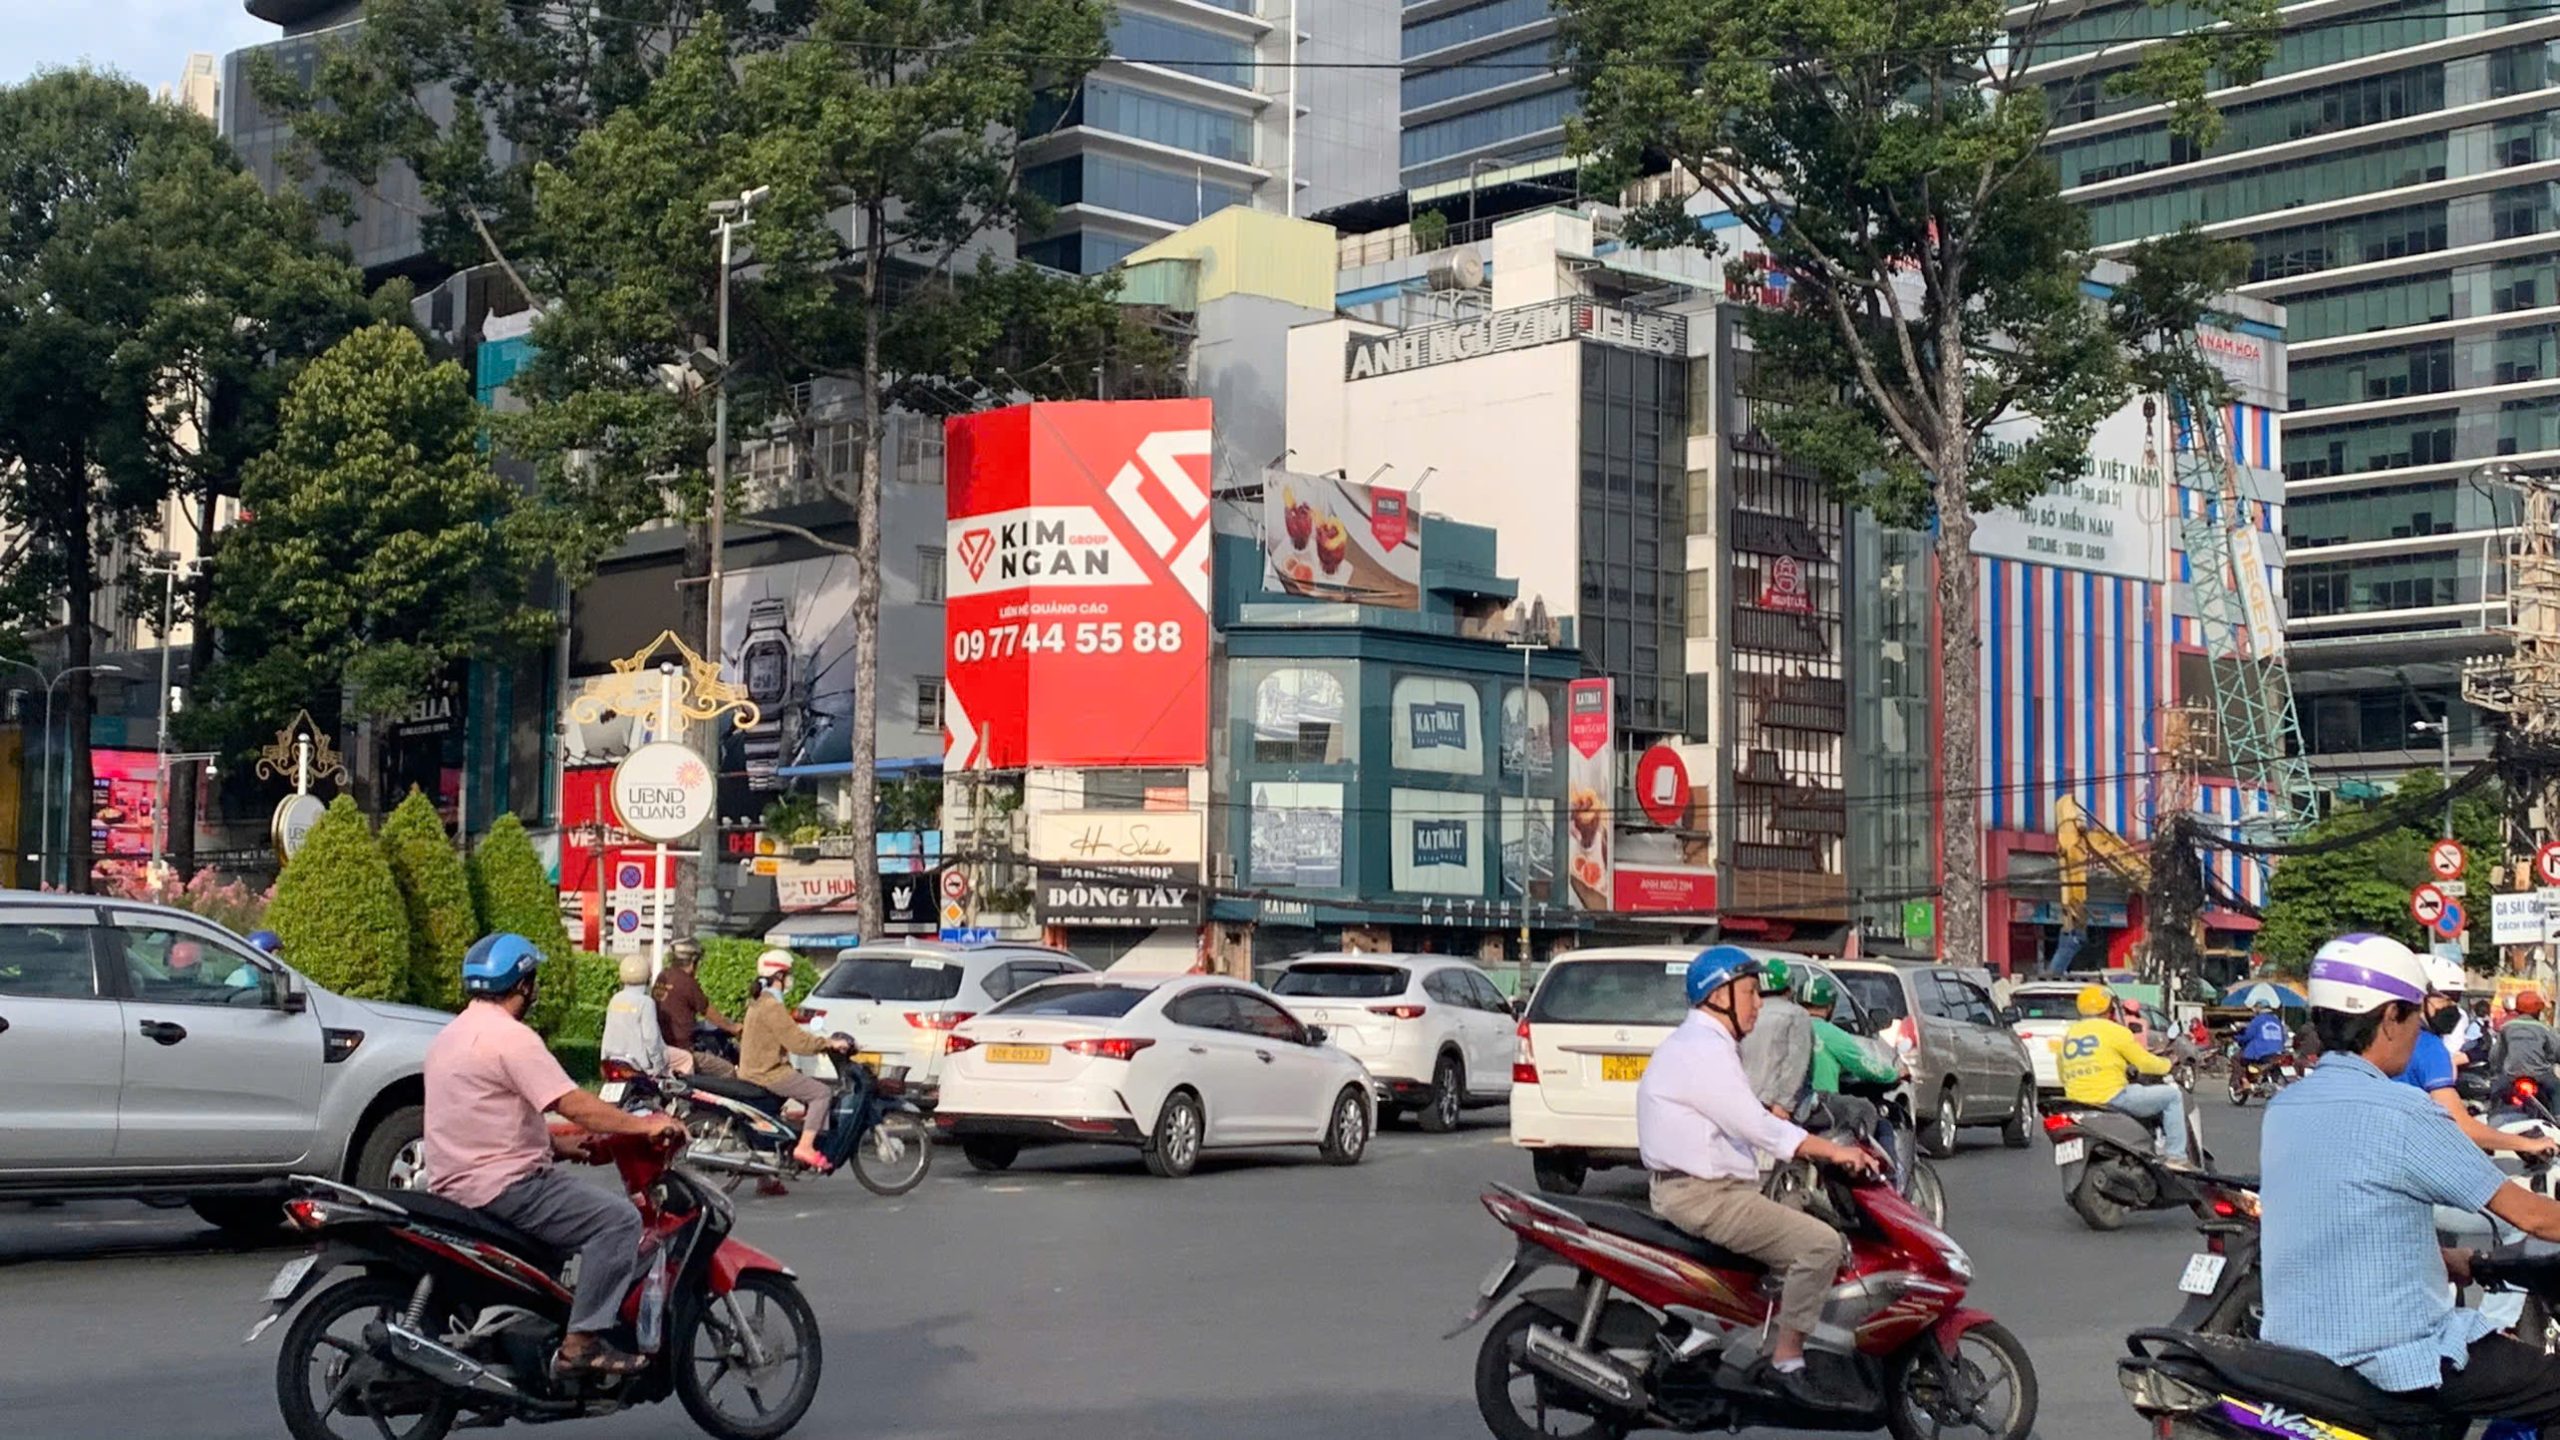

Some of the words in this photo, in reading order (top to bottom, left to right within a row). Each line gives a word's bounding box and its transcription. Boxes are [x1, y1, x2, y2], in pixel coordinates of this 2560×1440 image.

[1350, 333, 1422, 379] ANH
[1430, 314, 1498, 361] NGỮ
[1510, 305, 1571, 342] ZIM
[1592, 305, 1677, 355] IELTS
[2100, 457, 2126, 484] VIỆT
[2130, 465, 2160, 488] NAM
[1002, 520, 1065, 549] KIM
[1069, 535, 1109, 545] GROUP
[2089, 519, 2114, 538] NAM
[1002, 550, 1109, 579] NGAN
[1031, 600, 1077, 615] QUẢNG
[1079, 602, 1109, 614] CÁO
[1075, 622, 1123, 653] 55
[1132, 621, 1182, 653] 88
[1415, 710, 1460, 733] KATINAT
[629, 788, 685, 804] UBND
[1070, 825, 1113, 857] H
[1417, 828, 1462, 850] KATINAT
[801, 878, 823, 896] TƯ
[1048, 881, 1129, 907] ĐÔNG
